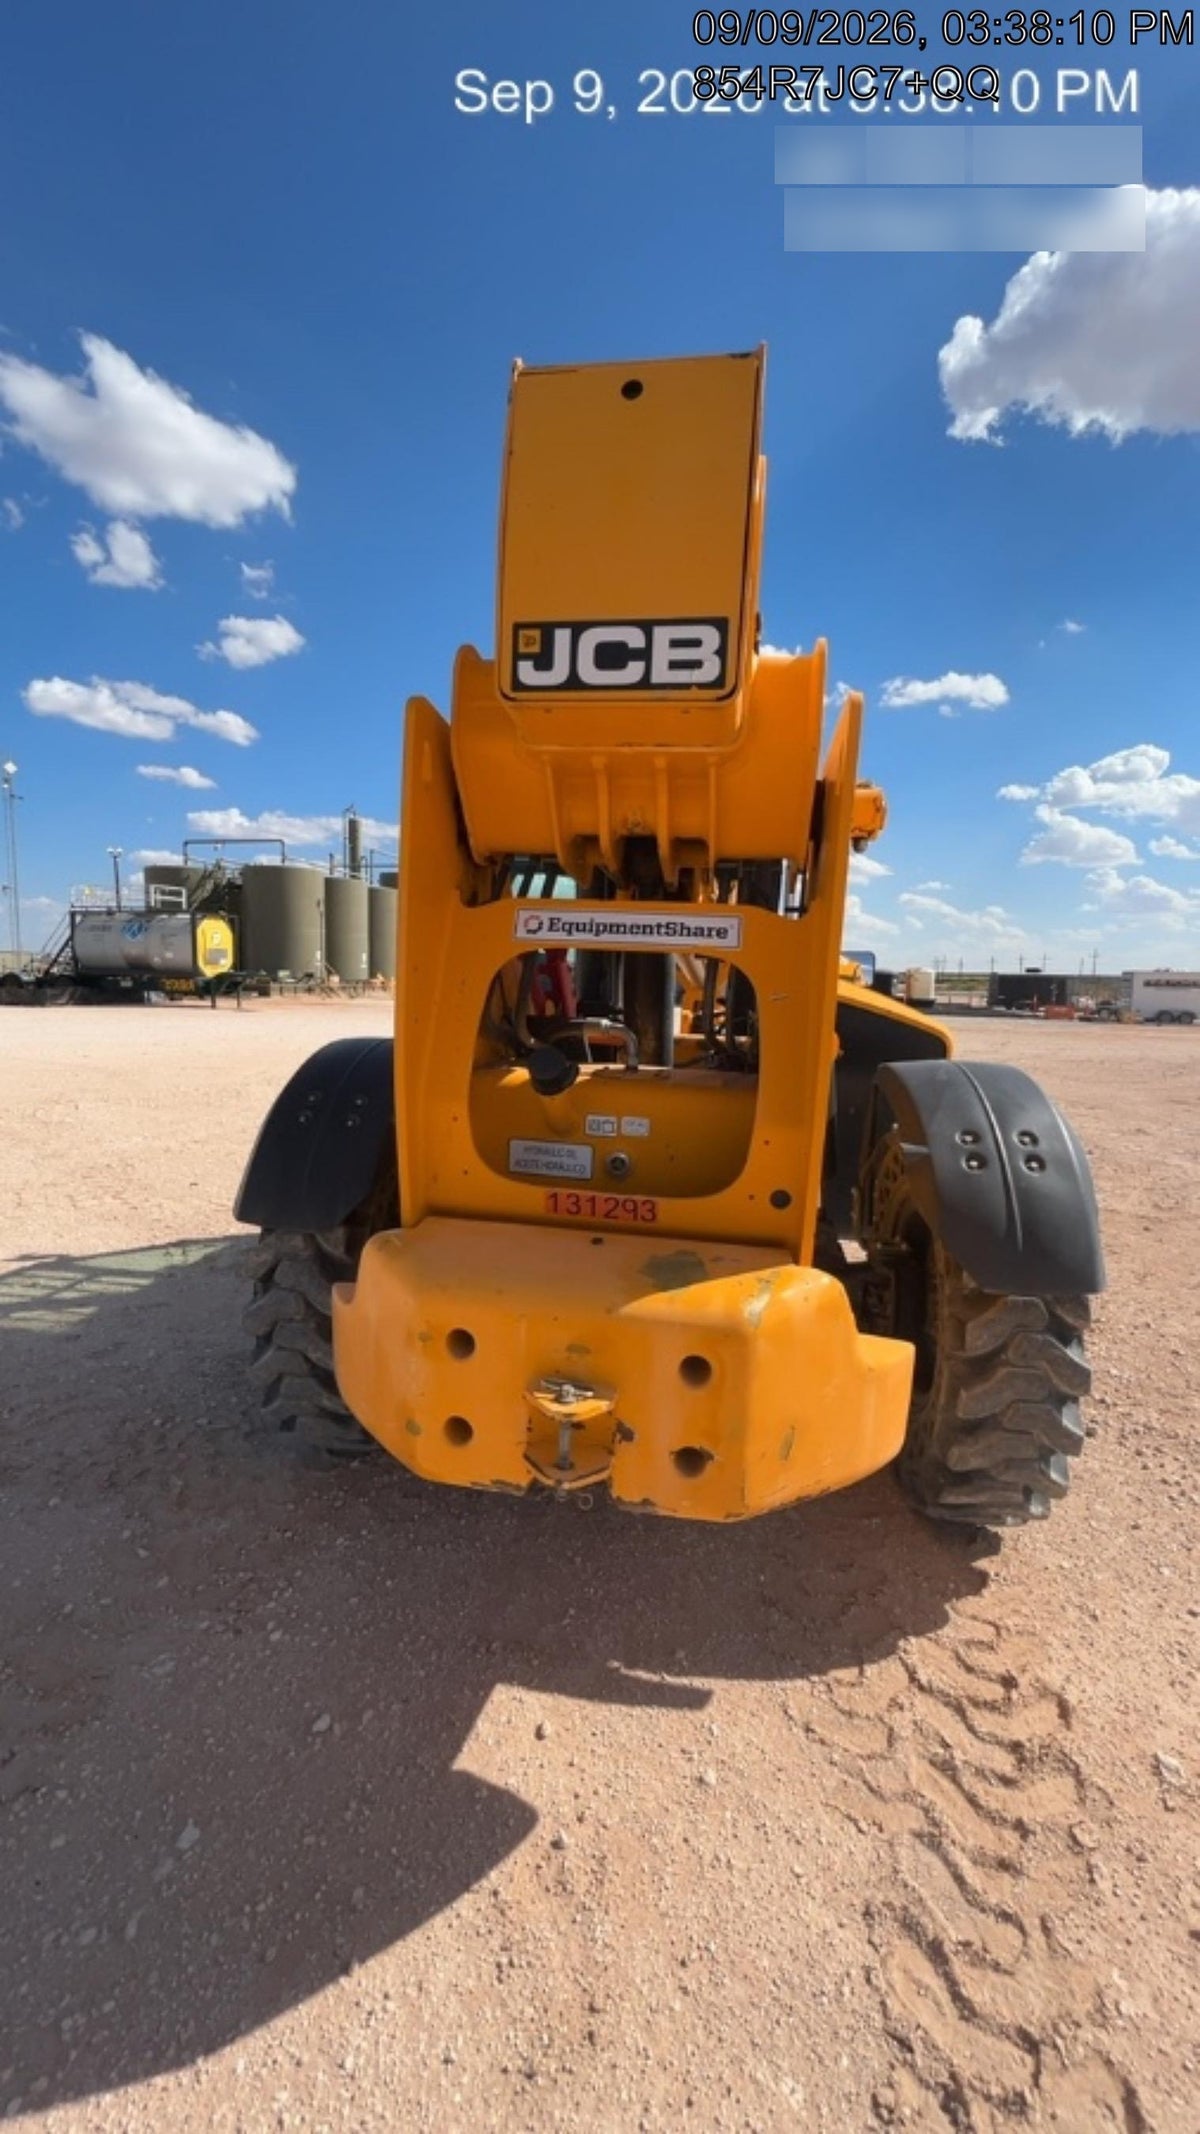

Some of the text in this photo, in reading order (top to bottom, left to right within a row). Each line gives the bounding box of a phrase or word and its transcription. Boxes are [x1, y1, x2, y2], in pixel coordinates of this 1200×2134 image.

[517, 624, 722, 687] JCB
[546, 916, 730, 940] EquipmentShare
[548, 1191, 658, 1223] 131293
